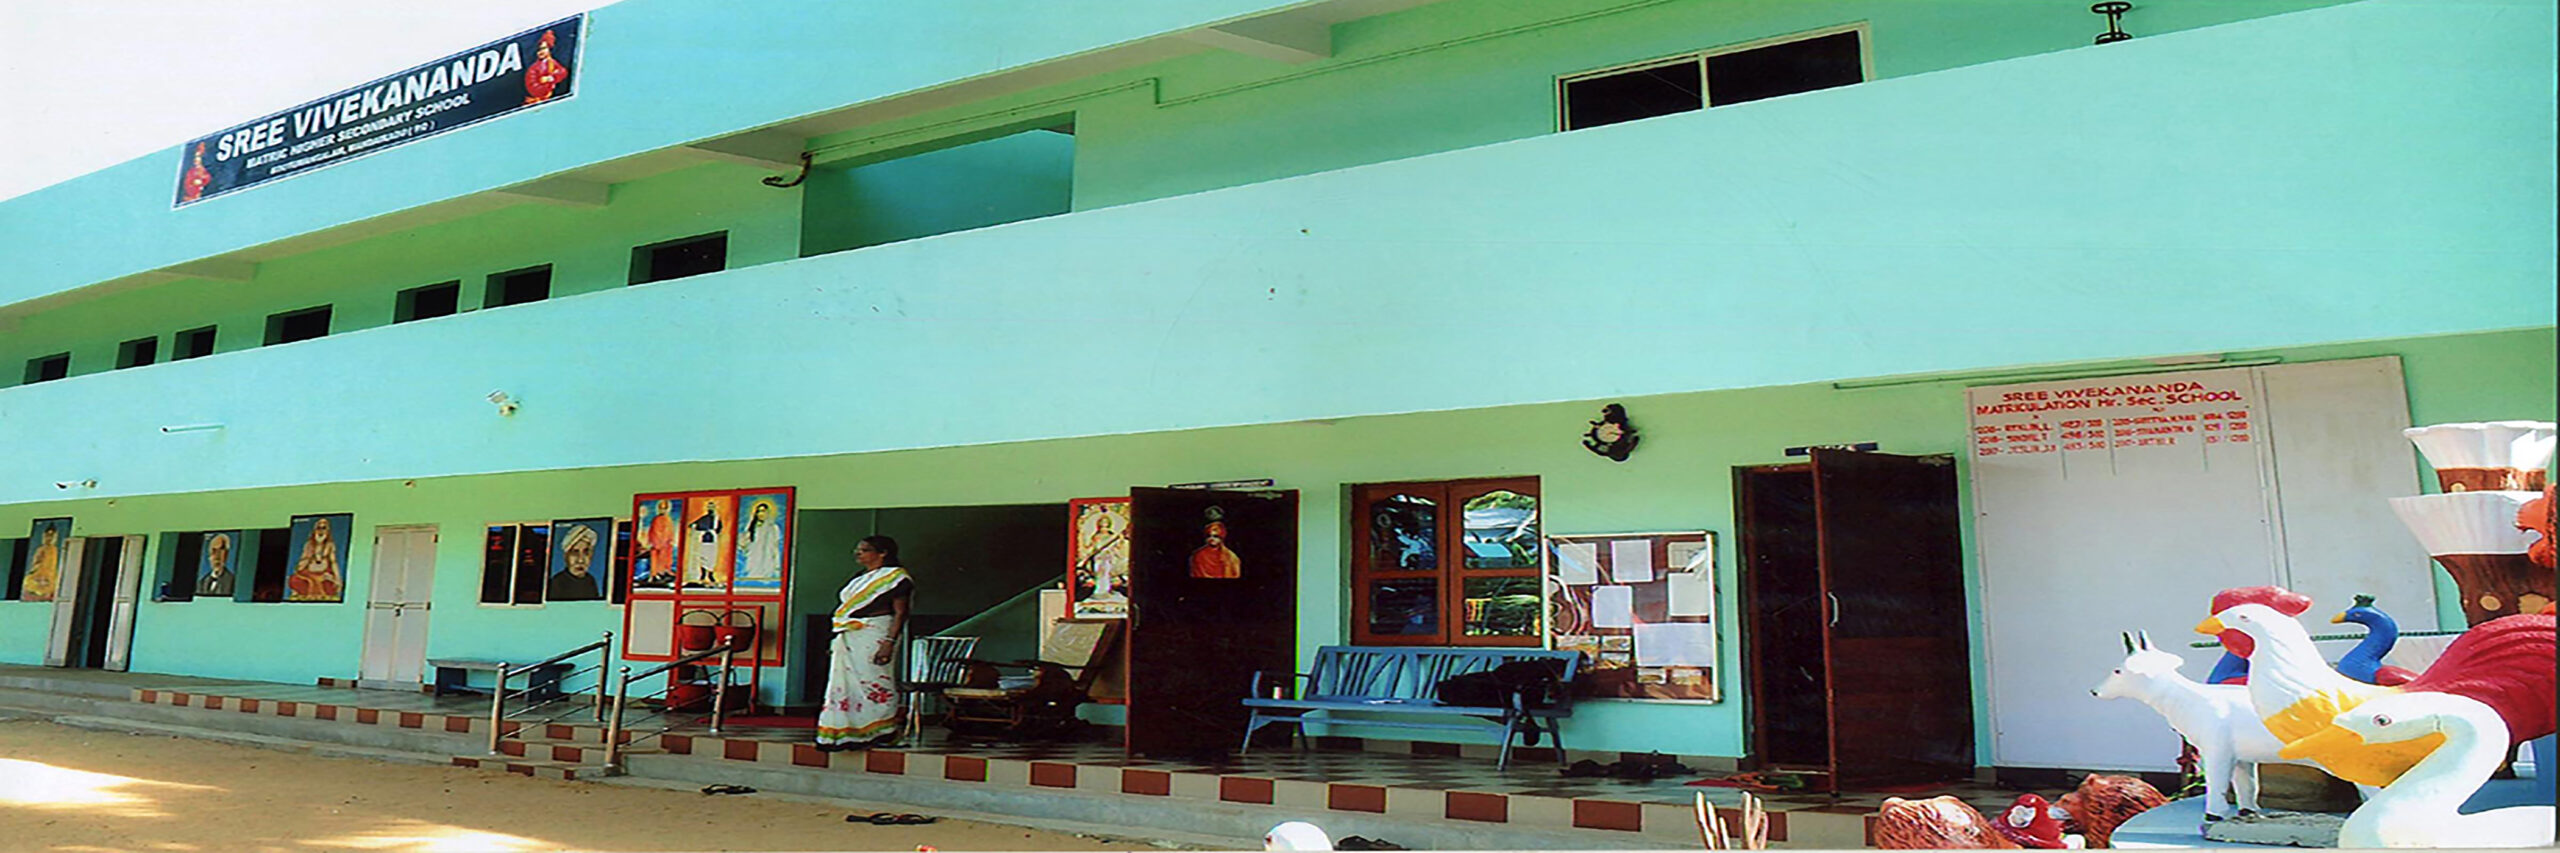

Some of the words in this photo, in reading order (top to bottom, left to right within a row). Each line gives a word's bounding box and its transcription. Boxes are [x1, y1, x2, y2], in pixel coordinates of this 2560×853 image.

[215, 117, 287, 162] SREE
[293, 42, 523, 138] VIVEKANANDA
[336, 108, 413, 143] SECONDARY
[415, 93, 471, 120] SCHOOL
[2002, 391, 2048, 402] SREE
[2054, 381, 2205, 399] VIVEKANANDA
[2165, 390, 2242, 404] SCHOOL
